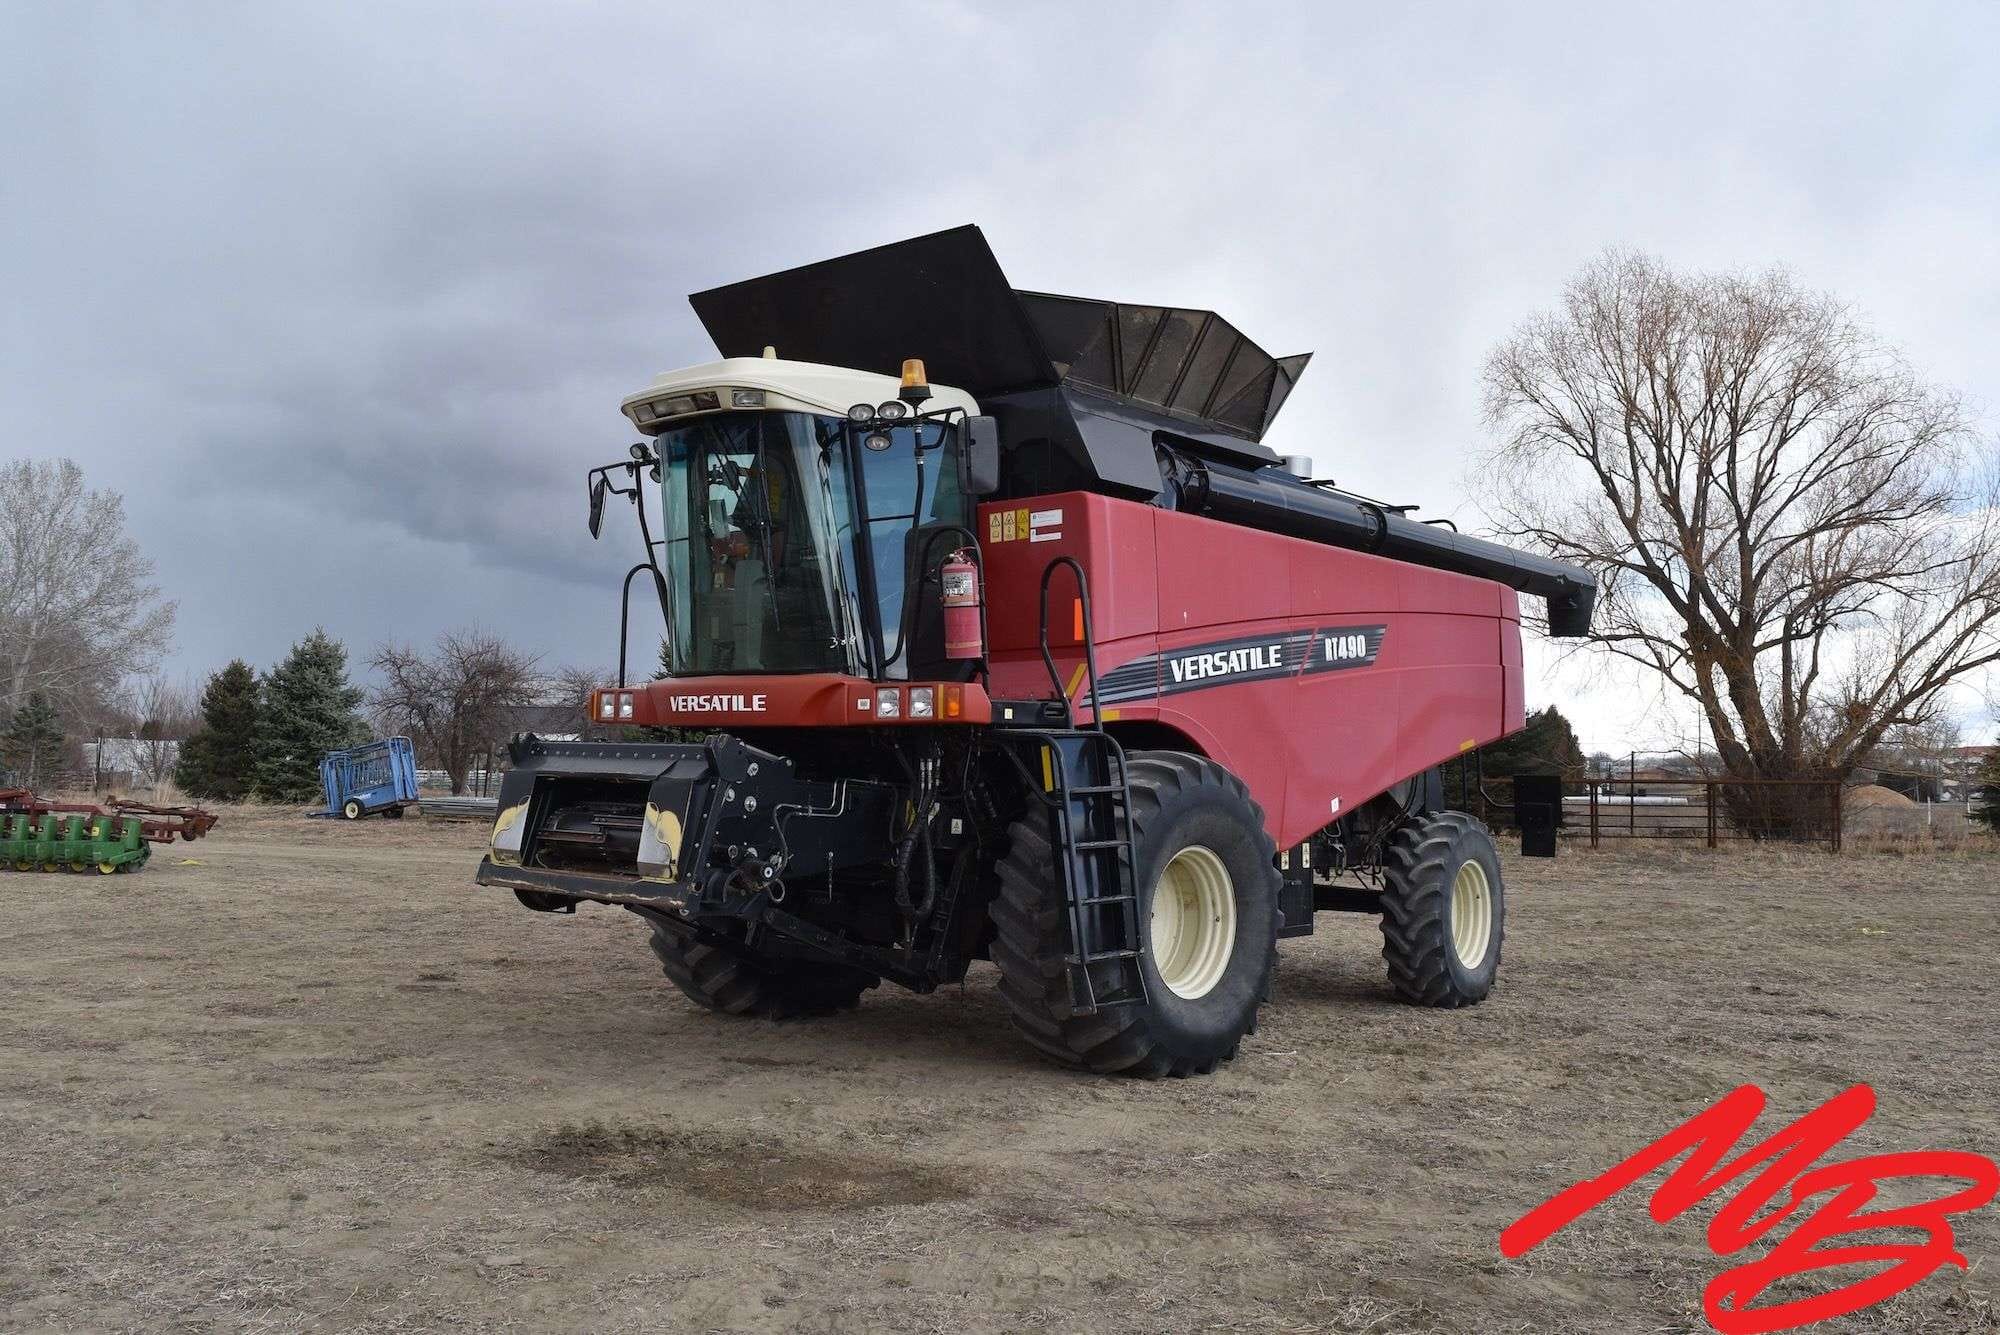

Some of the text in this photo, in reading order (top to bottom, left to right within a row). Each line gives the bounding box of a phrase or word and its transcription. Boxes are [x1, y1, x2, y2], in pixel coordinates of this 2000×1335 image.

[1170, 635, 1367, 683] VERSATILE RT490
[669, 694, 767, 712] VERSATILE
